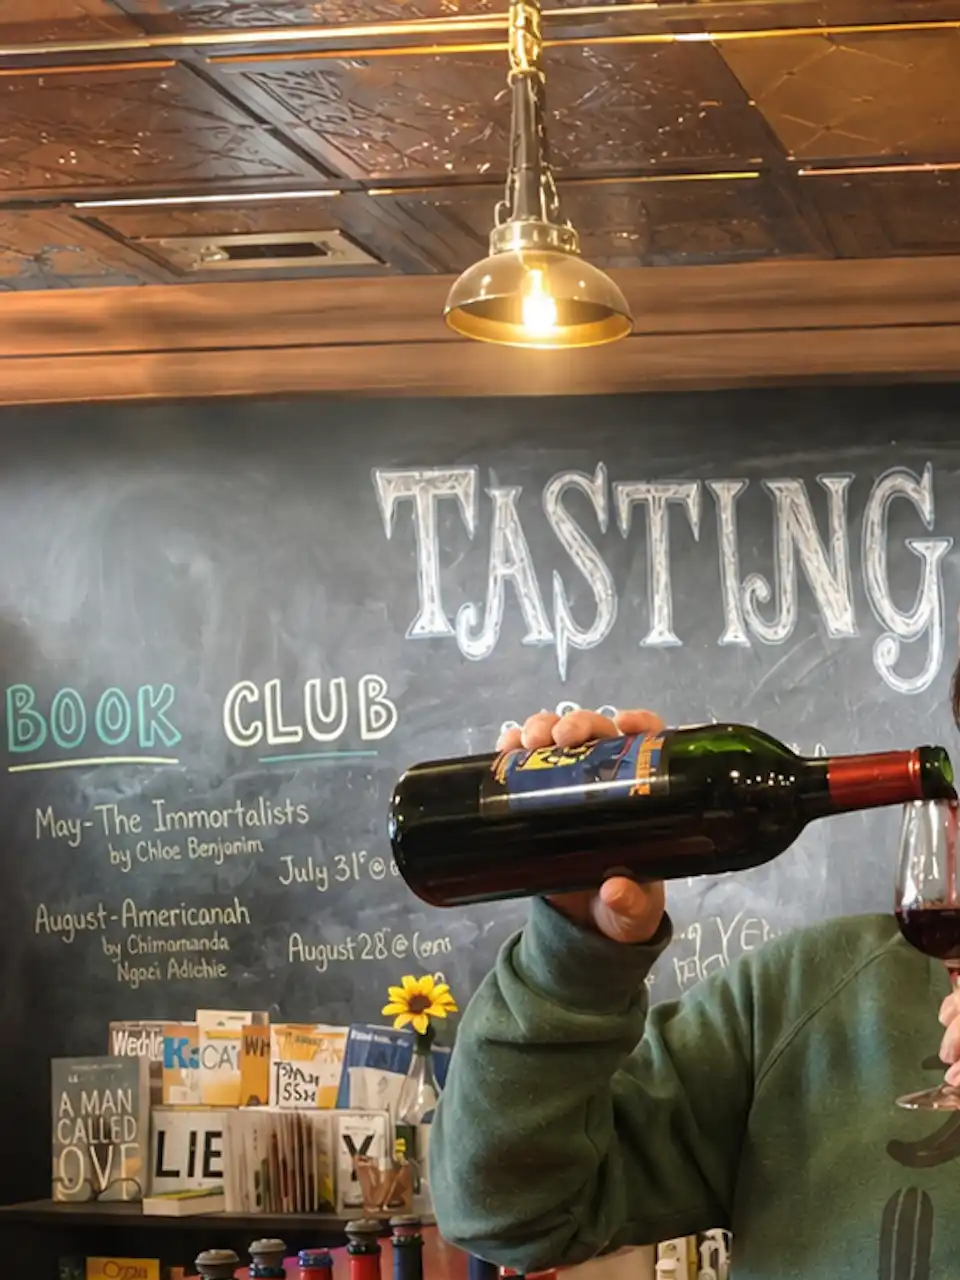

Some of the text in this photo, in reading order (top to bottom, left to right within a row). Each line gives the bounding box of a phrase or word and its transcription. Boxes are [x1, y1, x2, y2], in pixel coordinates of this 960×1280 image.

[372, 462, 954, 694] TASTING
[6, 674, 398, 753] BOOK CLUB
[151, 797, 310, 833] Immortalists
[109, 843, 131, 872] by
[136, 839, 182, 862] Chloe
[279, 854, 328, 892] July
[102, 936, 121, 963] by
[288, 932, 355, 973] August
[59, 1088, 132, 1117] A MAN
[57, 1116, 137, 1144] CALLED
[155, 1131, 223, 1178] LIE
